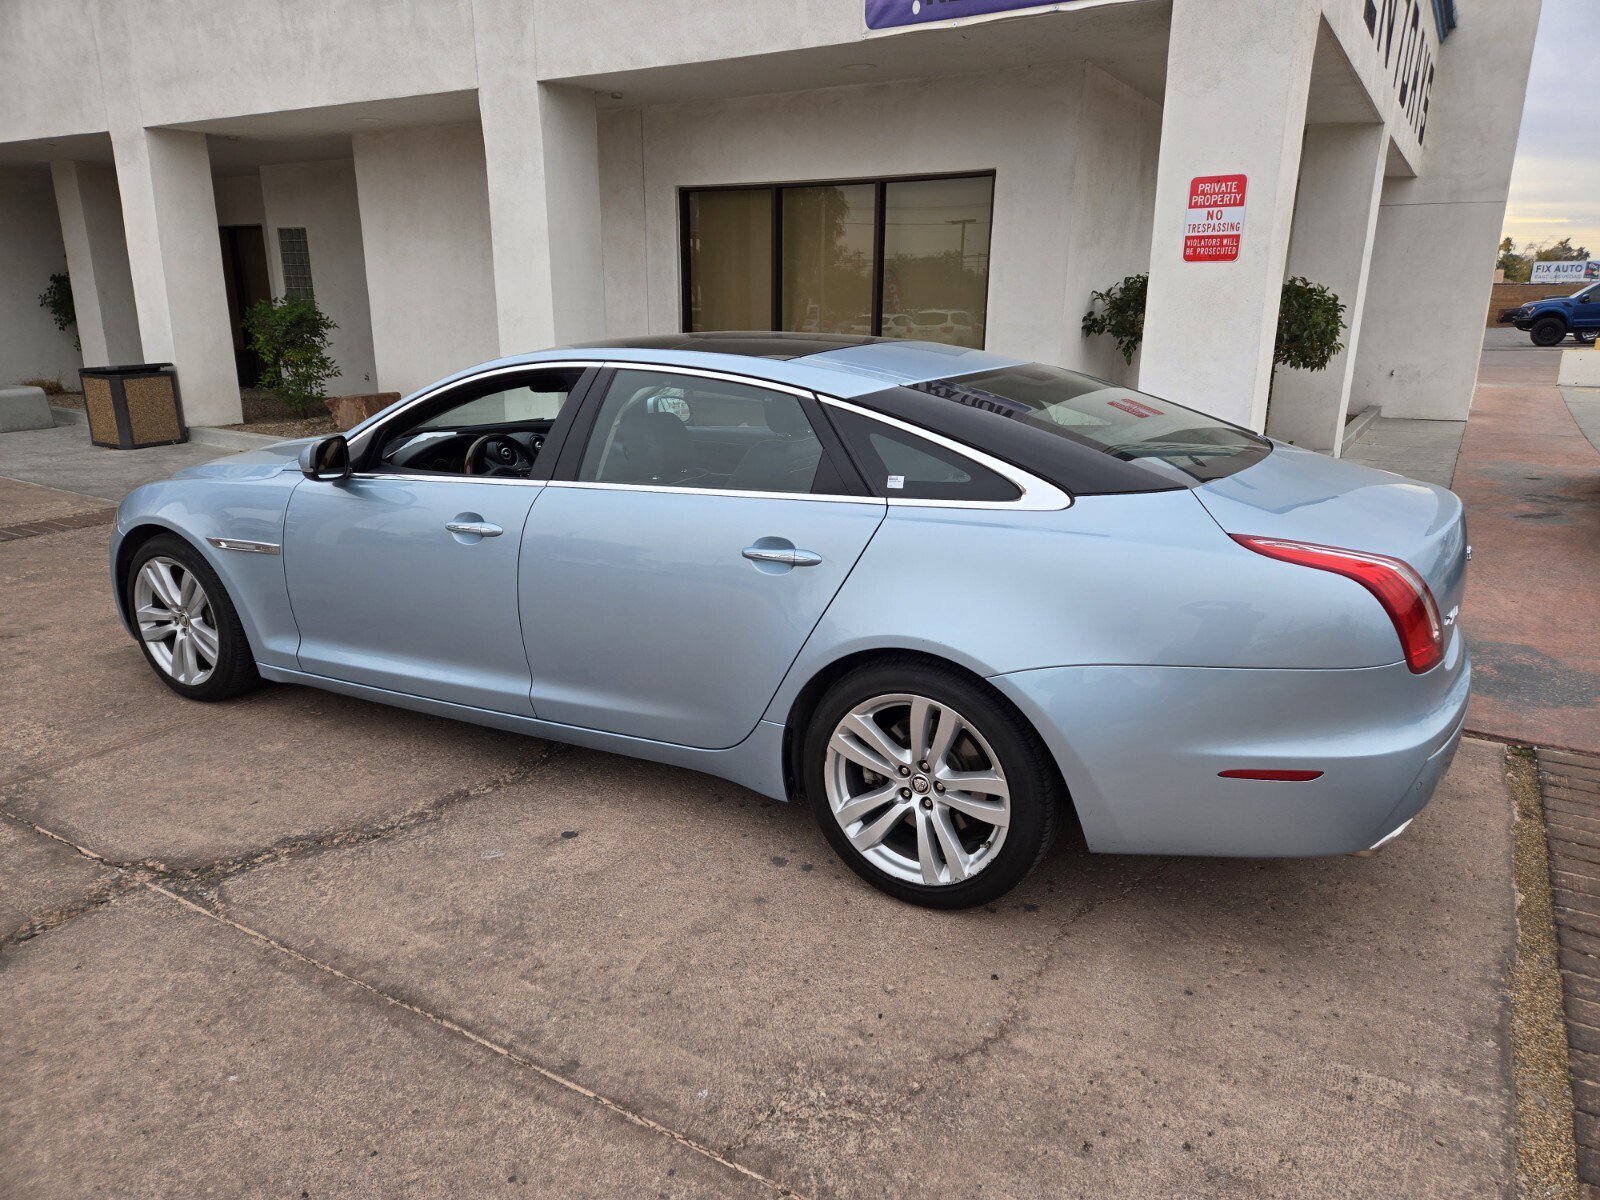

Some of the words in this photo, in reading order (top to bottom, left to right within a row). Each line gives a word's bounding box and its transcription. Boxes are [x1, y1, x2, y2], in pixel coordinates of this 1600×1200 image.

[1198, 182, 1238, 194] PRIVATE
[1192, 194, 1242, 206] PROPERTY
[1206, 209, 1223, 221] NO
[1187, 222, 1241, 233] TRESPASSING
[1186, 238, 1220, 246] VIOLATORS
[1222, 238, 1237, 246] WILL
[1185, 247, 1194, 255] BE
[1196, 246, 1237, 255] PROSECUTED
[1536, 265, 1552, 273] FIX
[1554, 265, 1583, 273] AUTO
